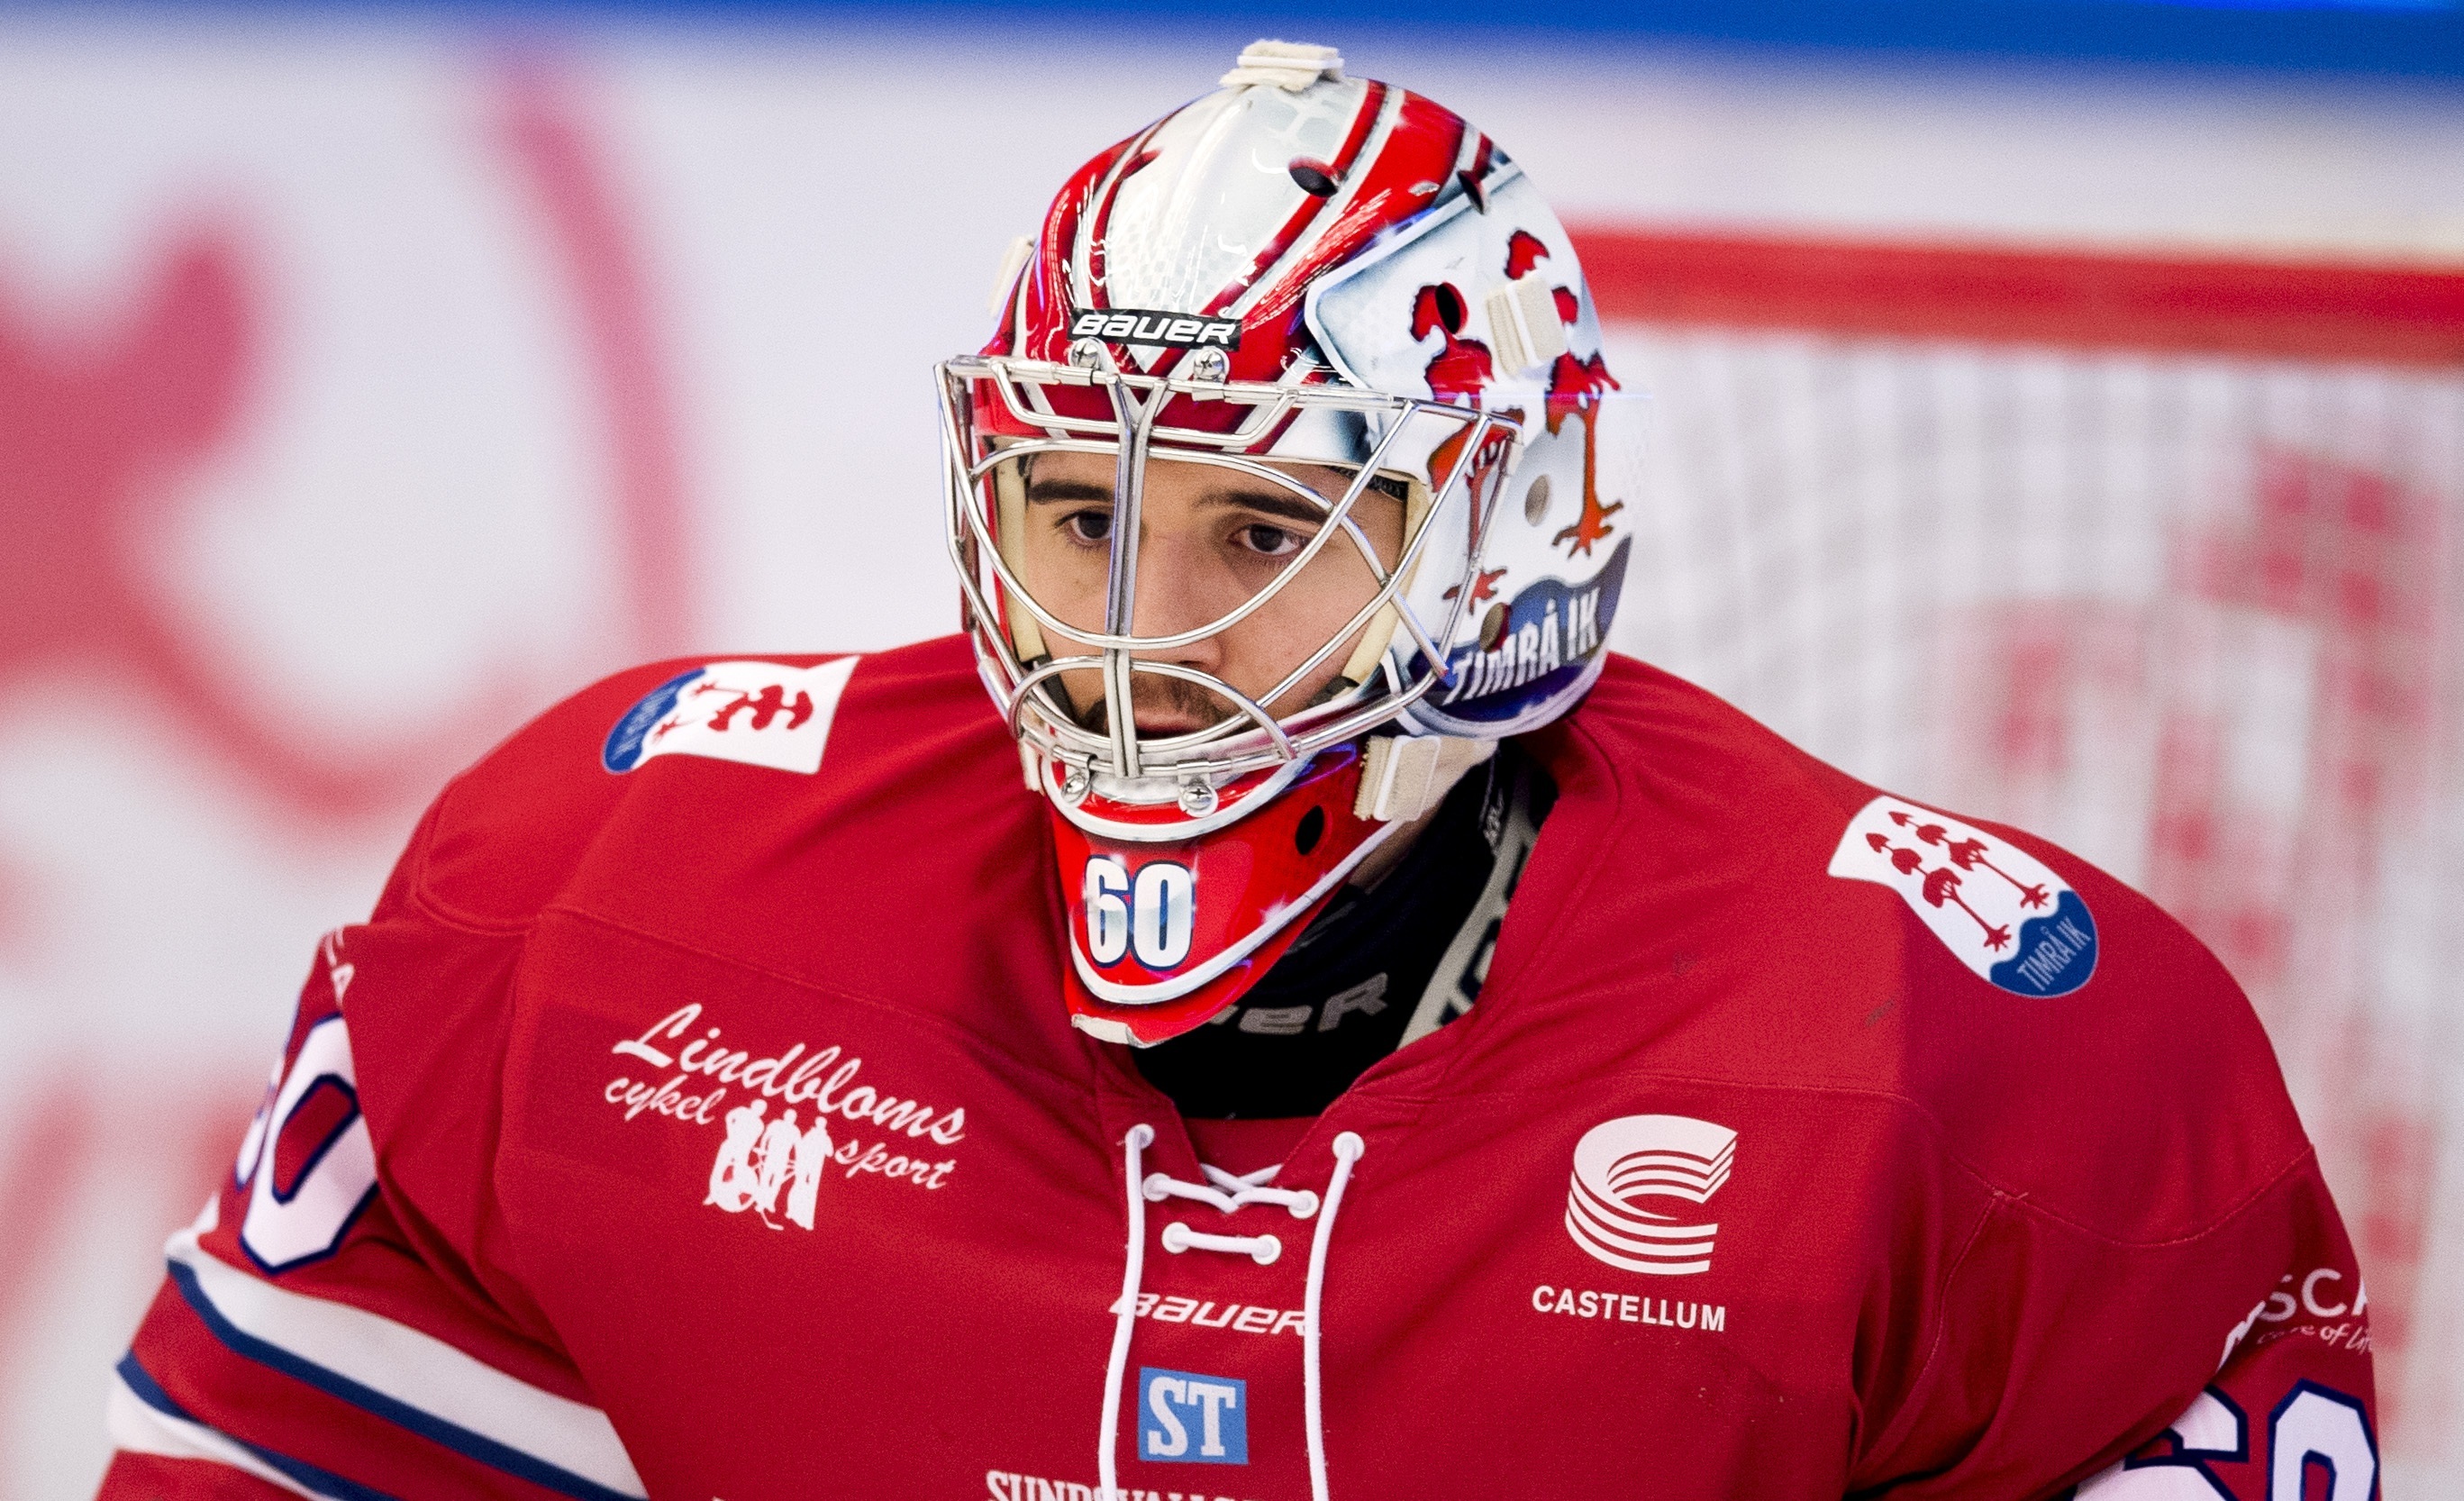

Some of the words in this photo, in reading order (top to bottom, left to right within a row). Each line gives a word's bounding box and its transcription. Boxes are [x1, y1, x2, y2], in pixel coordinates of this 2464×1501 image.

[1442, 598, 1560, 706] TIMRÅ
[1567, 587, 1600, 661] IK
[1084, 855, 1196, 969] 60
[2016, 925, 2077, 991] TIMRÅ
[2056, 915, 2092, 951] IK
[612, 1003, 966, 1145] Lindbloms
[234, 1009, 379, 1275] 0
[605, 1074, 726, 1124] cykel
[834, 1140, 957, 1189] sport
[1532, 1285, 1726, 1332] CASTELLUM
[1148, 1377, 1236, 1457] ST
